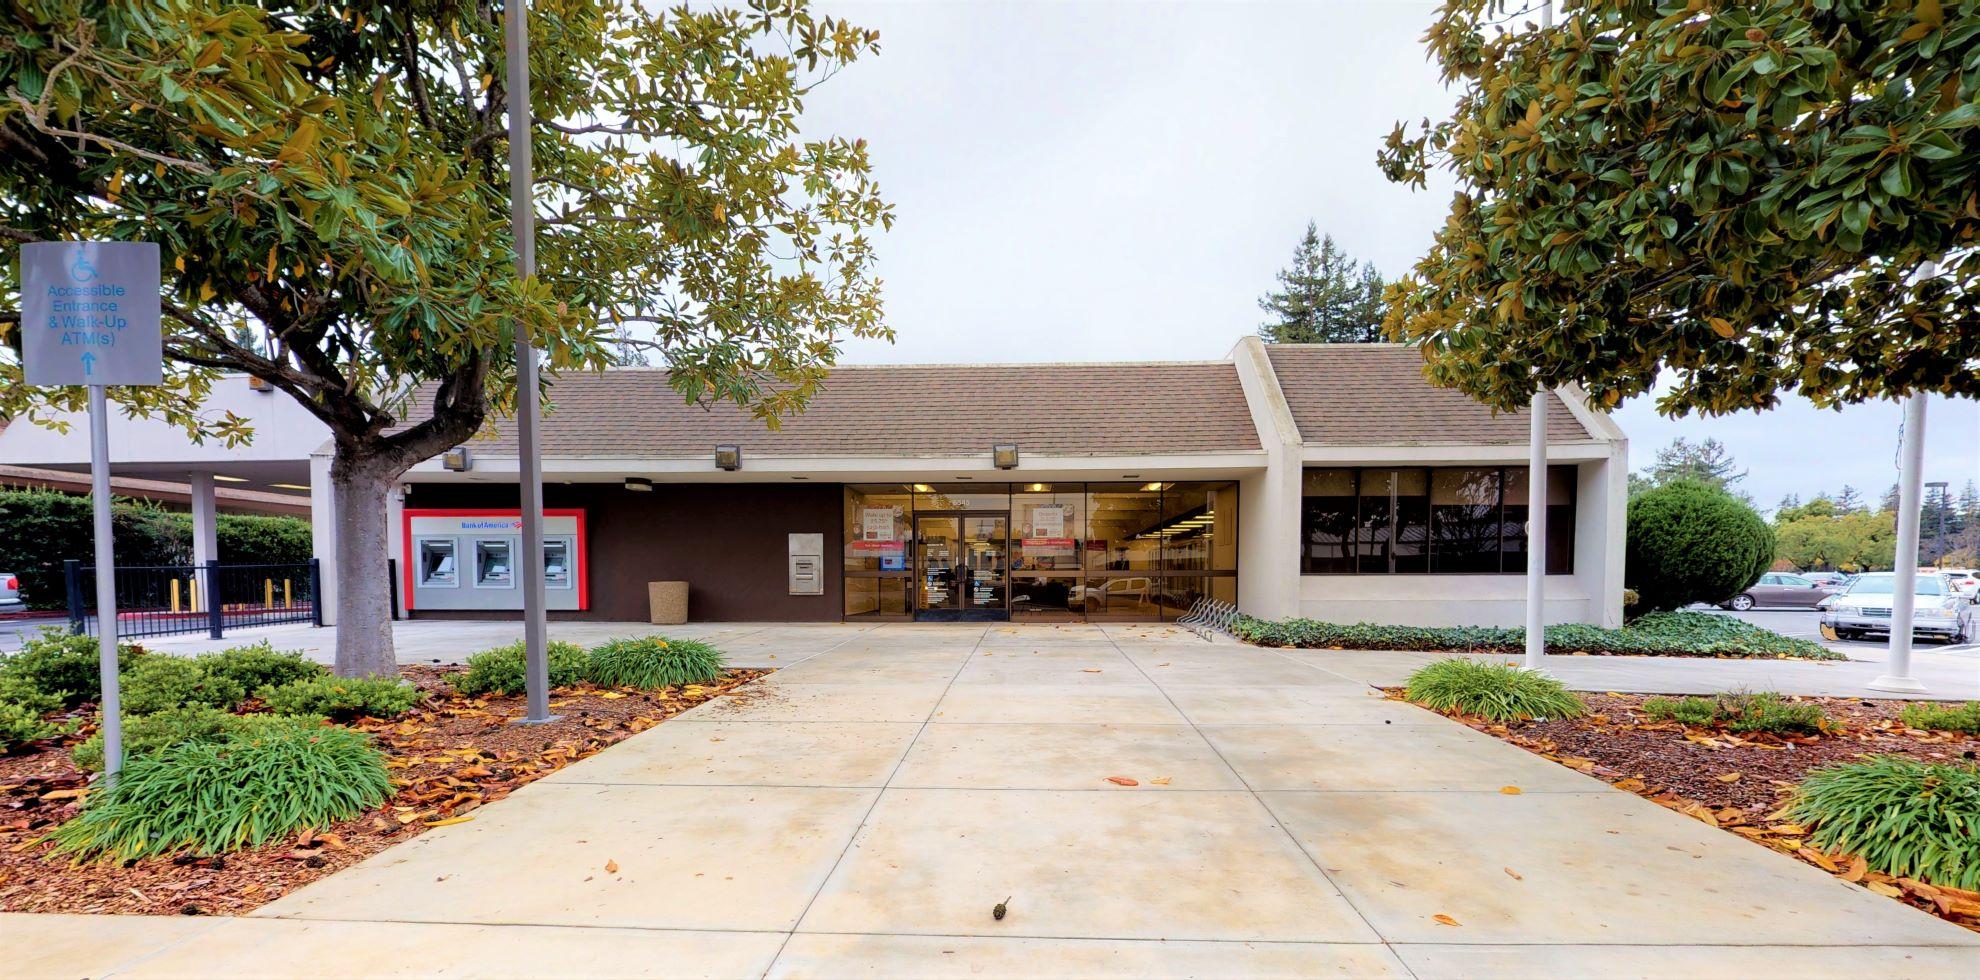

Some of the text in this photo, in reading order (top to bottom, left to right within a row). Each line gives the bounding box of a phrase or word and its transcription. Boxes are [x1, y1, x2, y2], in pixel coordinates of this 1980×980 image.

[48, 284, 126, 297] Accessible
[52, 301, 118, 312] Entrance
[48, 315, 127, 331] & Walk-Up
[61, 332, 116, 347] ATM(s)
